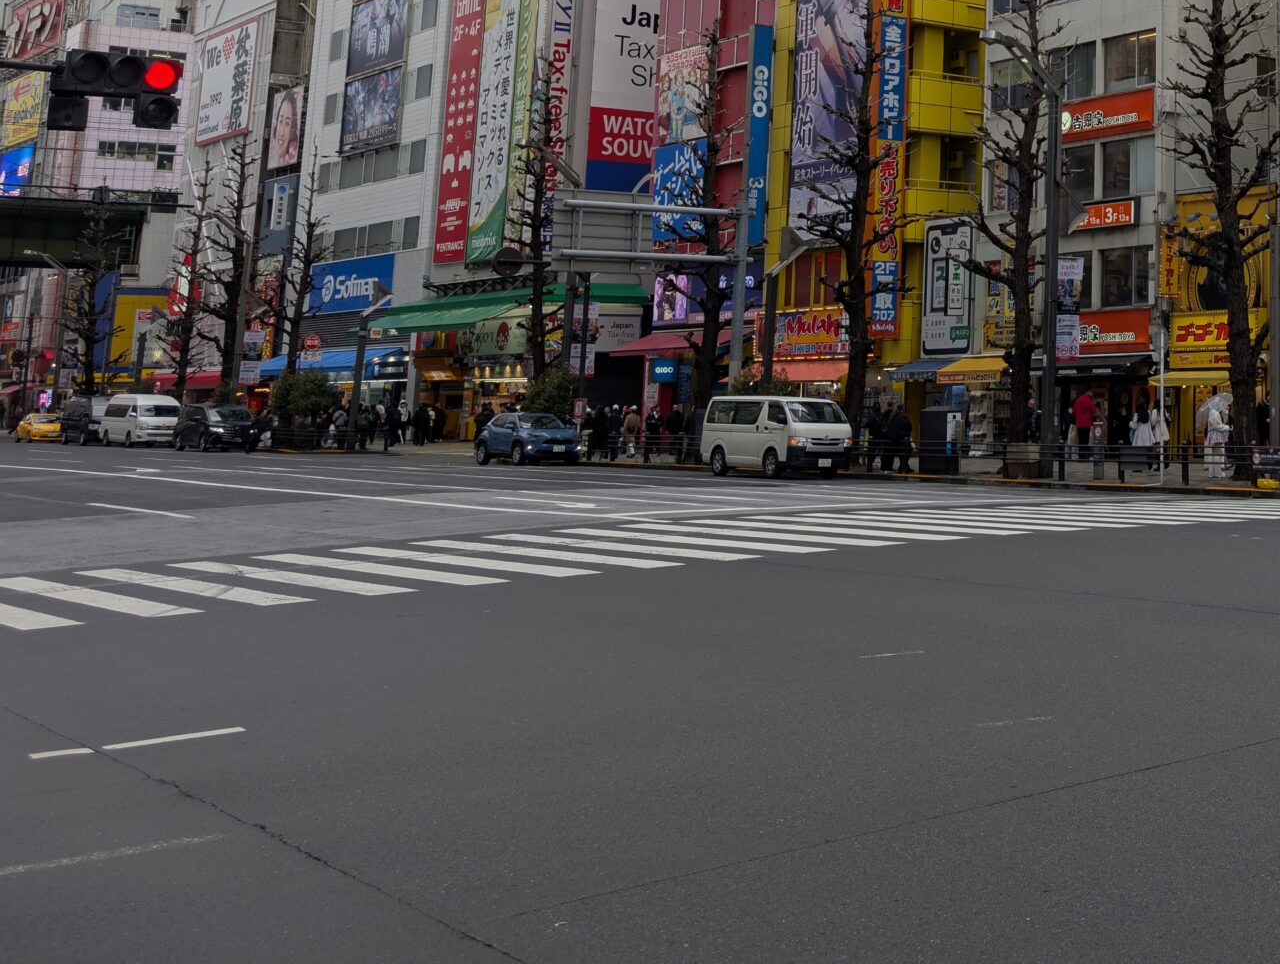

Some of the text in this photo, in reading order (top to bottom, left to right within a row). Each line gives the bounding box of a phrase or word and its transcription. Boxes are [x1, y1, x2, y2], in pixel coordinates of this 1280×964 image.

[366, 25, 392, 60] 鳴潮
[206, 46, 221, 69] We
[551, 39, 572, 78] Tax
[227, 26, 250, 132] 秋葉原
[210, 92, 222, 107] 1992
[752, 65, 769, 118] GiGO
[1072, 110, 1139, 131] 吉野家 YOSHINOYA
[474, 87, 491, 218] アロマソープ
[445, 198, 461, 211] Hey
[1104, 207, 1118, 224] 3F
[439, 240, 464, 252] ENTRANCE
[874, 262, 896, 275] 2F
[872, 310, 895, 322] フロア
[611, 321, 634, 332] Japan
[785, 313, 841, 339] Mulan
[871, 322, 895, 334] Mulan
[1079, 324, 1100, 342] 野家
